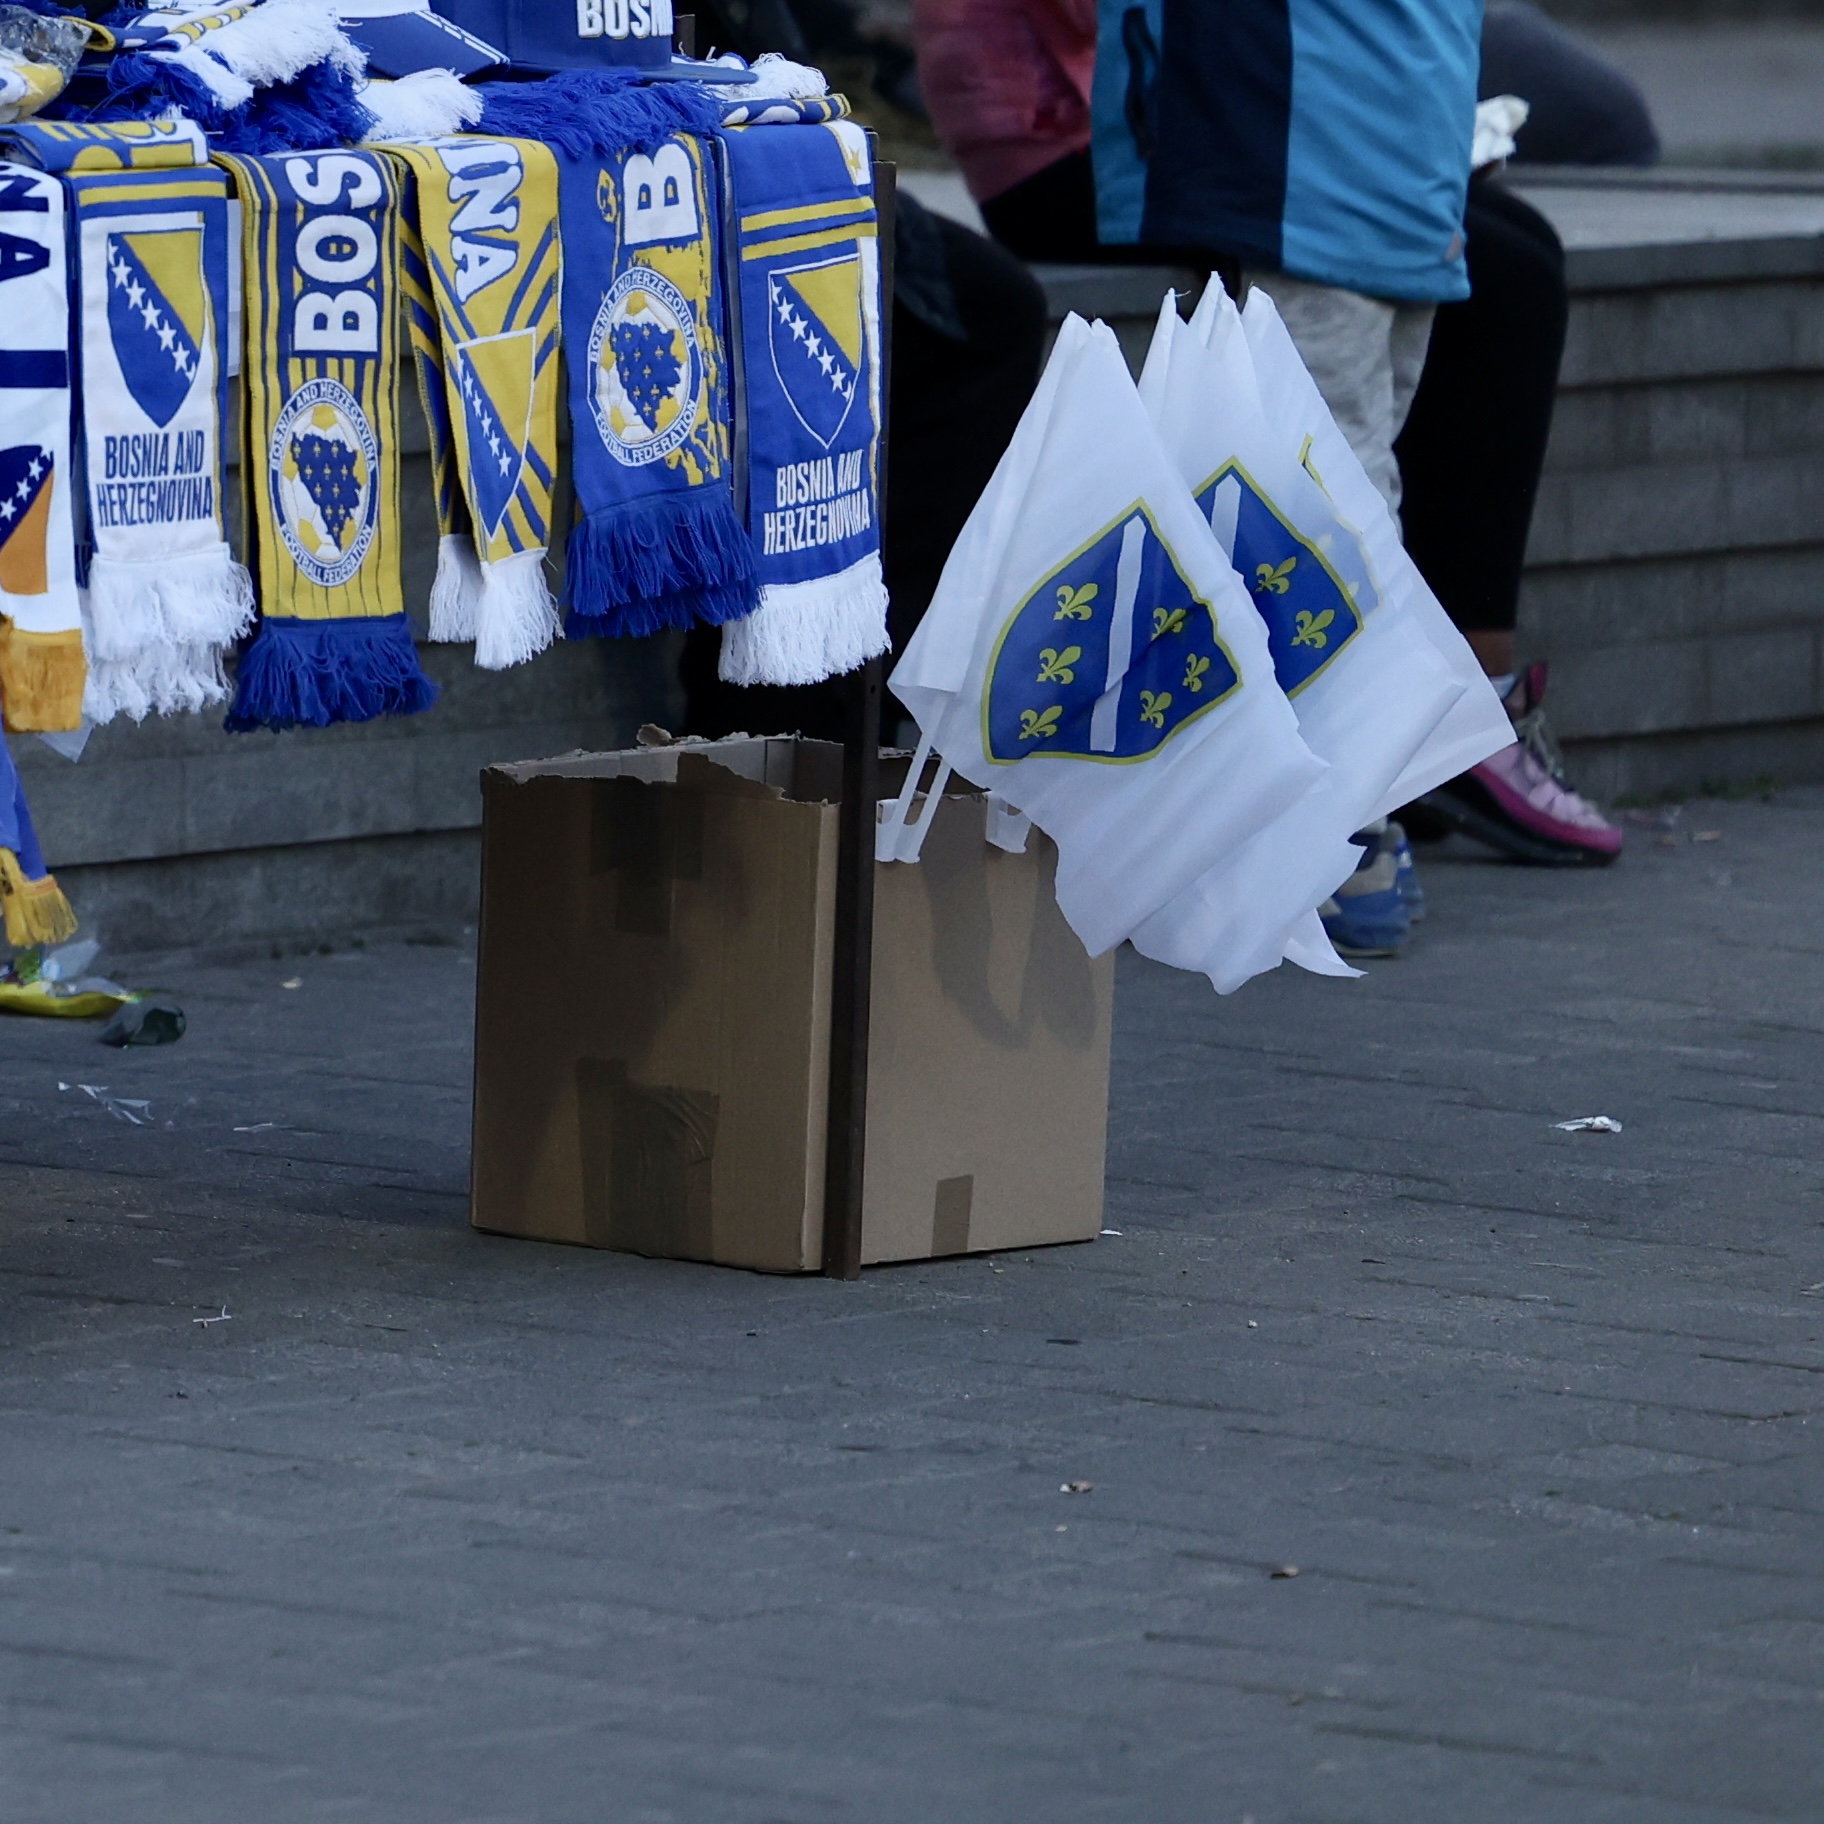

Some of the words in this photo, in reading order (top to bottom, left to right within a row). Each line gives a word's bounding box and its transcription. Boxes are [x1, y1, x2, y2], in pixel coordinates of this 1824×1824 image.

[105, 432, 170, 479] BOSNIA
[173, 429, 205, 475] AND
[776, 456, 835, 509] BOSNIA
[836, 449, 864, 495] AND
